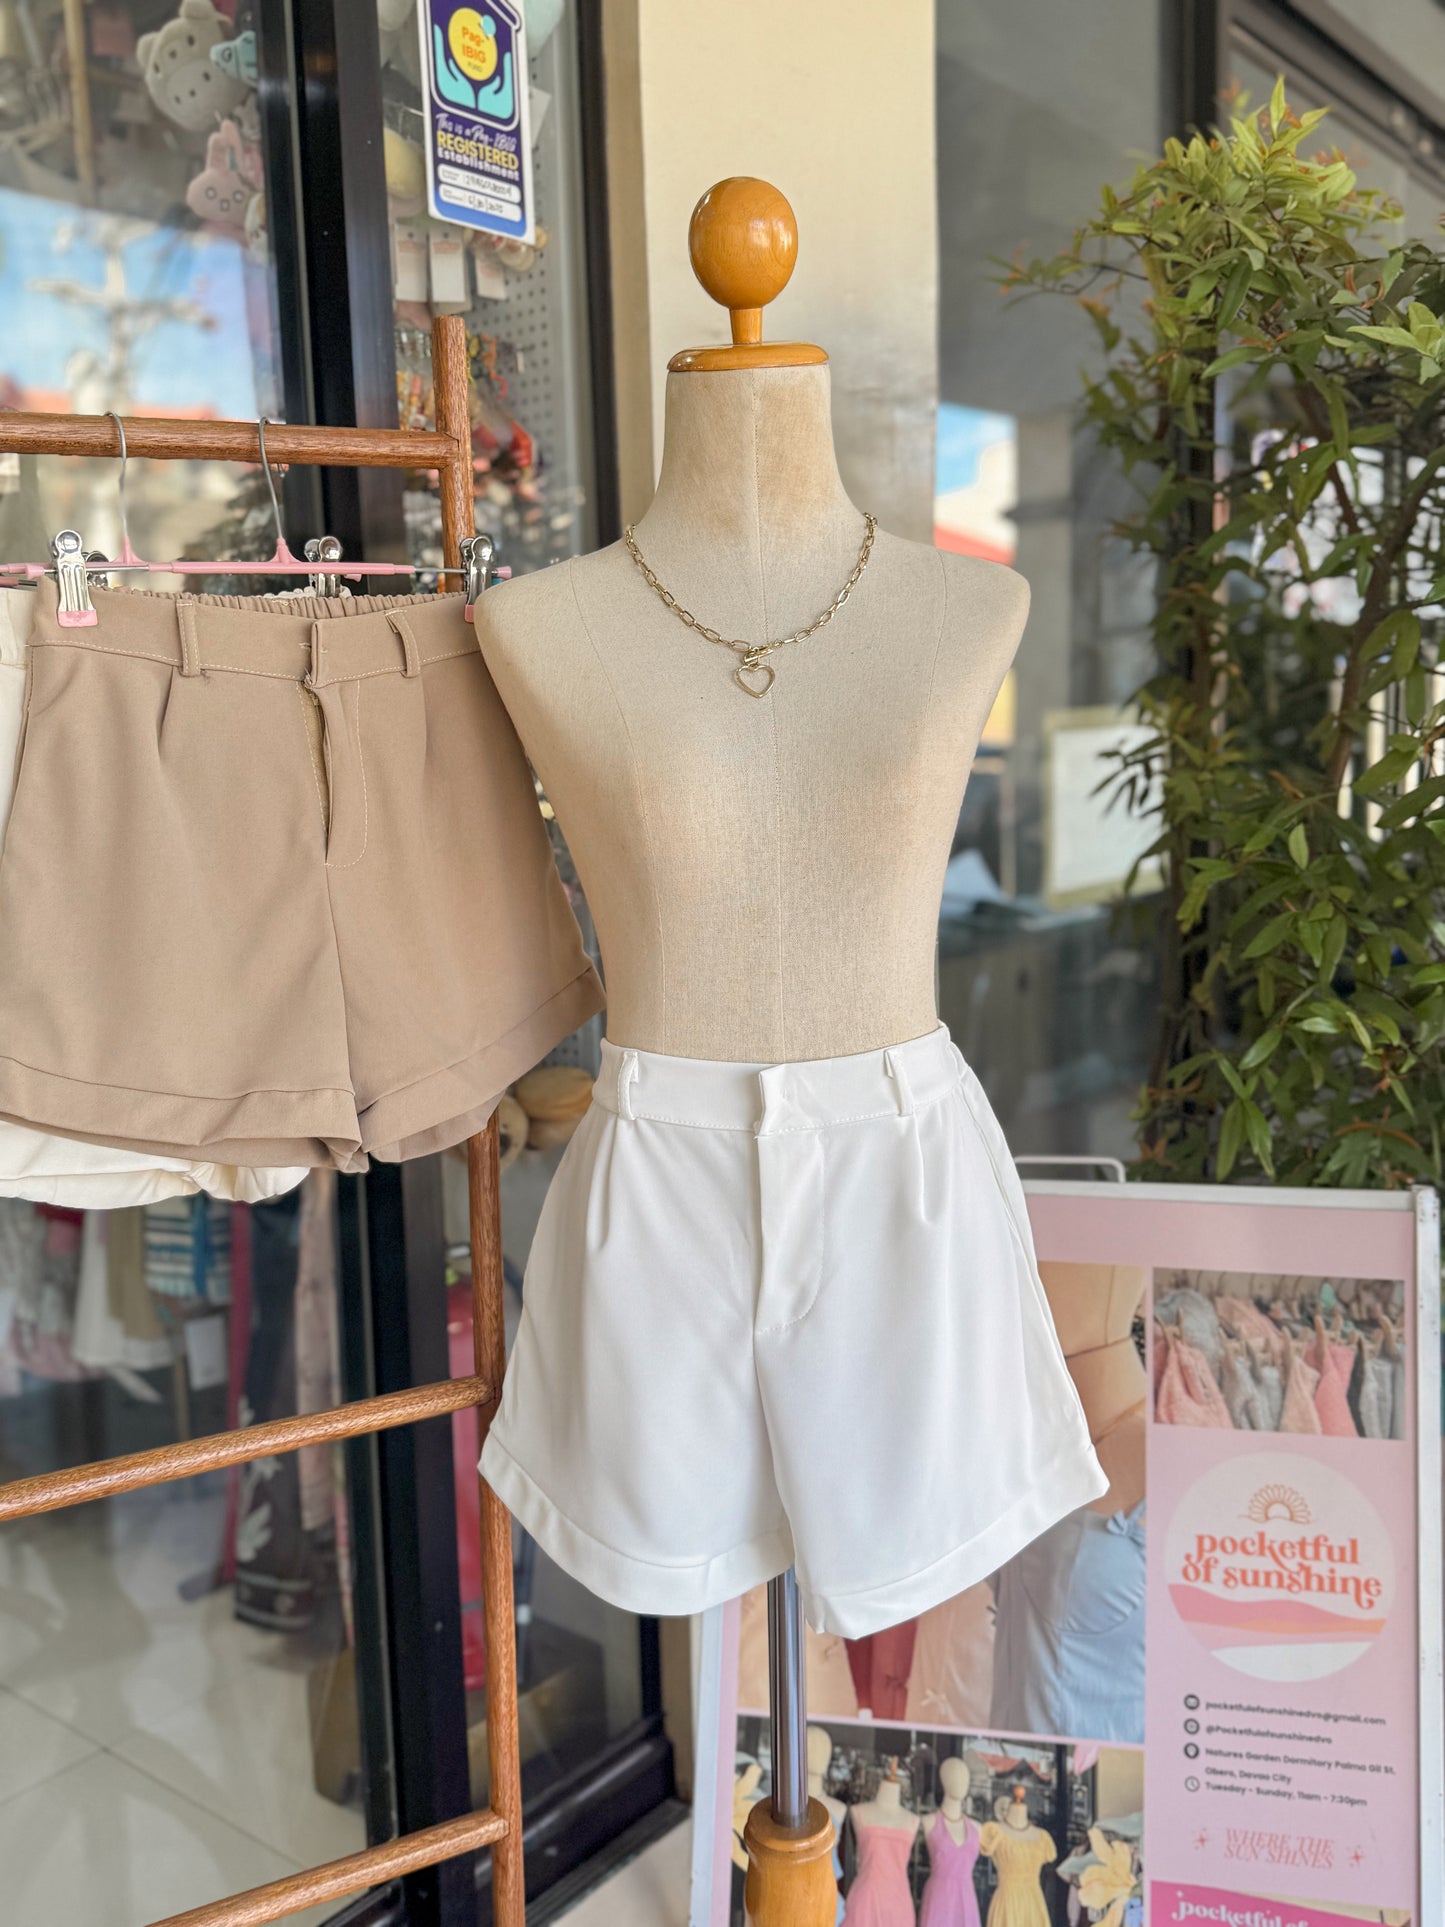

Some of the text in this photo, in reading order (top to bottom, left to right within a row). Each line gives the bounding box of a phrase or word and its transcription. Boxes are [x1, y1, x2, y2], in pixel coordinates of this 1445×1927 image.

[462, 26, 485, 47] Pag-
[462, 44, 486, 63] IBIG
[437, 130, 519, 171] REGISTERED
[437, 146, 520, 182] Establishment
[1194, 1530, 1360, 1572] pocketful
[1181, 1551, 1382, 1610] of sunshine
[1205, 1747, 1244, 1760] Natures
[1245, 1751, 1282, 1763] Garden
[1283, 1755, 1333, 1771] Dormitory
[1334, 1760, 1367, 1772] Palma
[1368, 1763, 1383, 1773] Gil
[1239, 1770, 1271, 1781] Davao
[1272, 1773, 1293, 1786] City
[1205, 1781, 1247, 1796] Tuesday
[1297, 1790, 1322, 1802] 11am
[1330, 1794, 1368, 1808] 7:30pm
[1223, 1844, 1334, 1869] SUN SHINES
[1226, 1828, 1335, 1858] WHERE THE
[1171, 1899, 1281, 1927] pocketful
